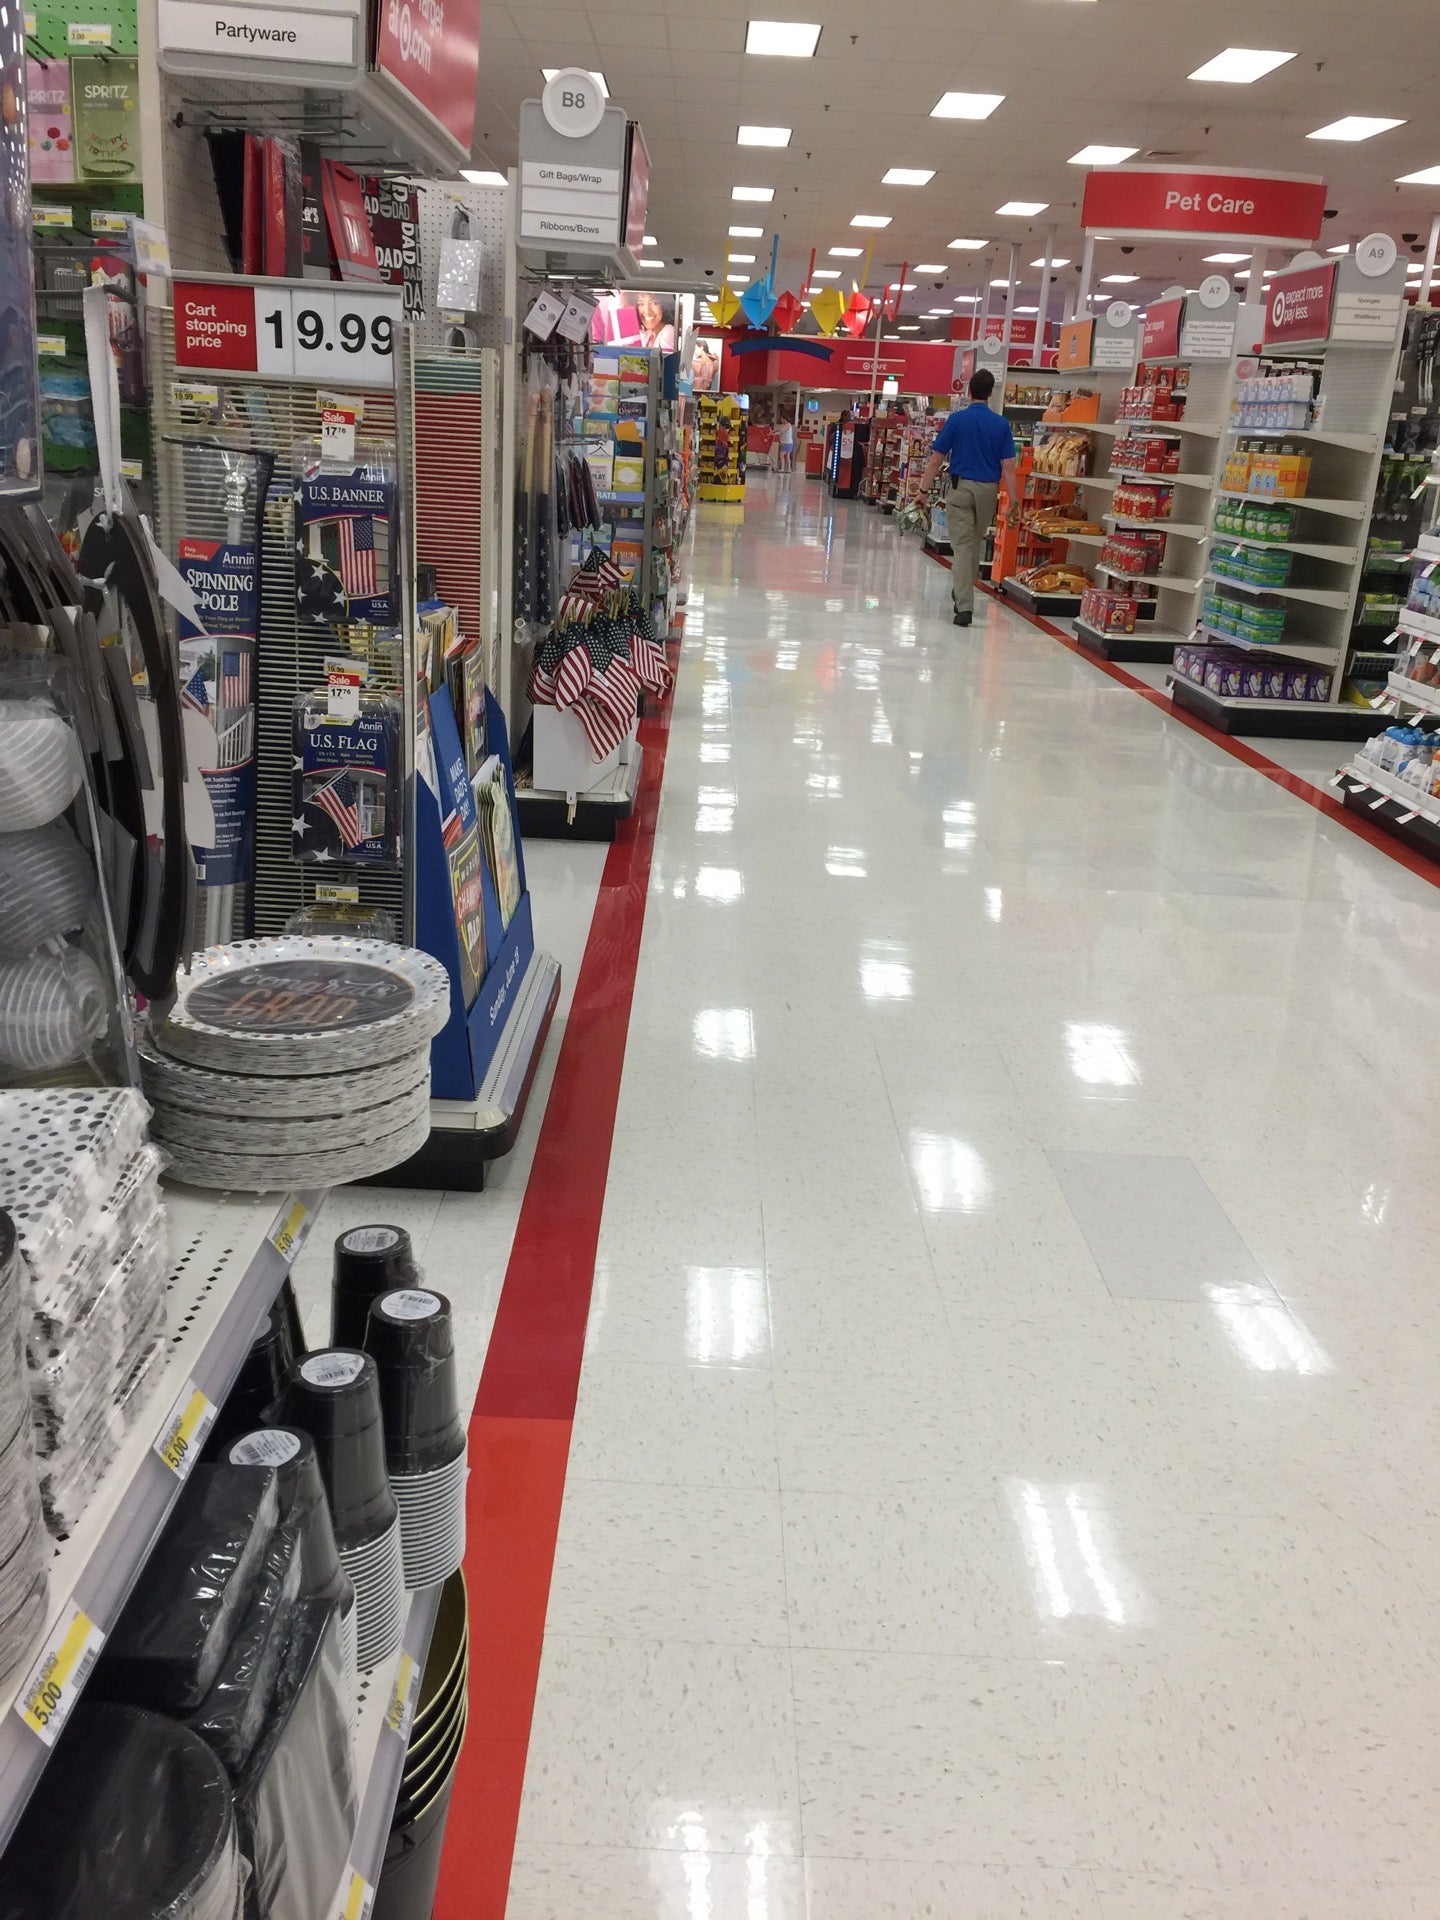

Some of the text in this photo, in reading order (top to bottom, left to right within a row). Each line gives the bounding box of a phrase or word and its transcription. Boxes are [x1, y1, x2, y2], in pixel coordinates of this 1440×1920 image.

[215, 21, 297, 43] Partyware
[562, 92, 585, 108] B8
[539, 170, 602, 184] Gift Bags/Wrap
[1165, 191, 1255, 215] Pet Care
[540, 221, 600, 234] Ribbons/Bows
[375, 246, 403, 269] DAD
[1368, 248, 1384, 258] A9
[1285, 286, 1307, 305] expect
[185, 302, 217, 317] Cart
[1283, 308, 1295, 325] pay
[185, 319, 247, 338] stopping
[264, 309, 393, 355] 19.99
[186, 335, 222, 349] price
[323, 411, 346, 424] Sale
[309, 486, 385, 503] U.S. BANNER
[222, 552, 254, 565] Annin
[187, 568, 253, 591] SPINNING
[201, 591, 239, 611] POLE
[329, 675, 350, 685] Sale
[359, 721, 383, 731] Annin
[310, 734, 378, 751] U.S. FLAG
[450, 757, 463, 784] MAKE
[454, 777, 467, 804] DAD'S
[168, 1436, 188, 1467] 5.00
[34, 1681, 62, 1725] 5.00
